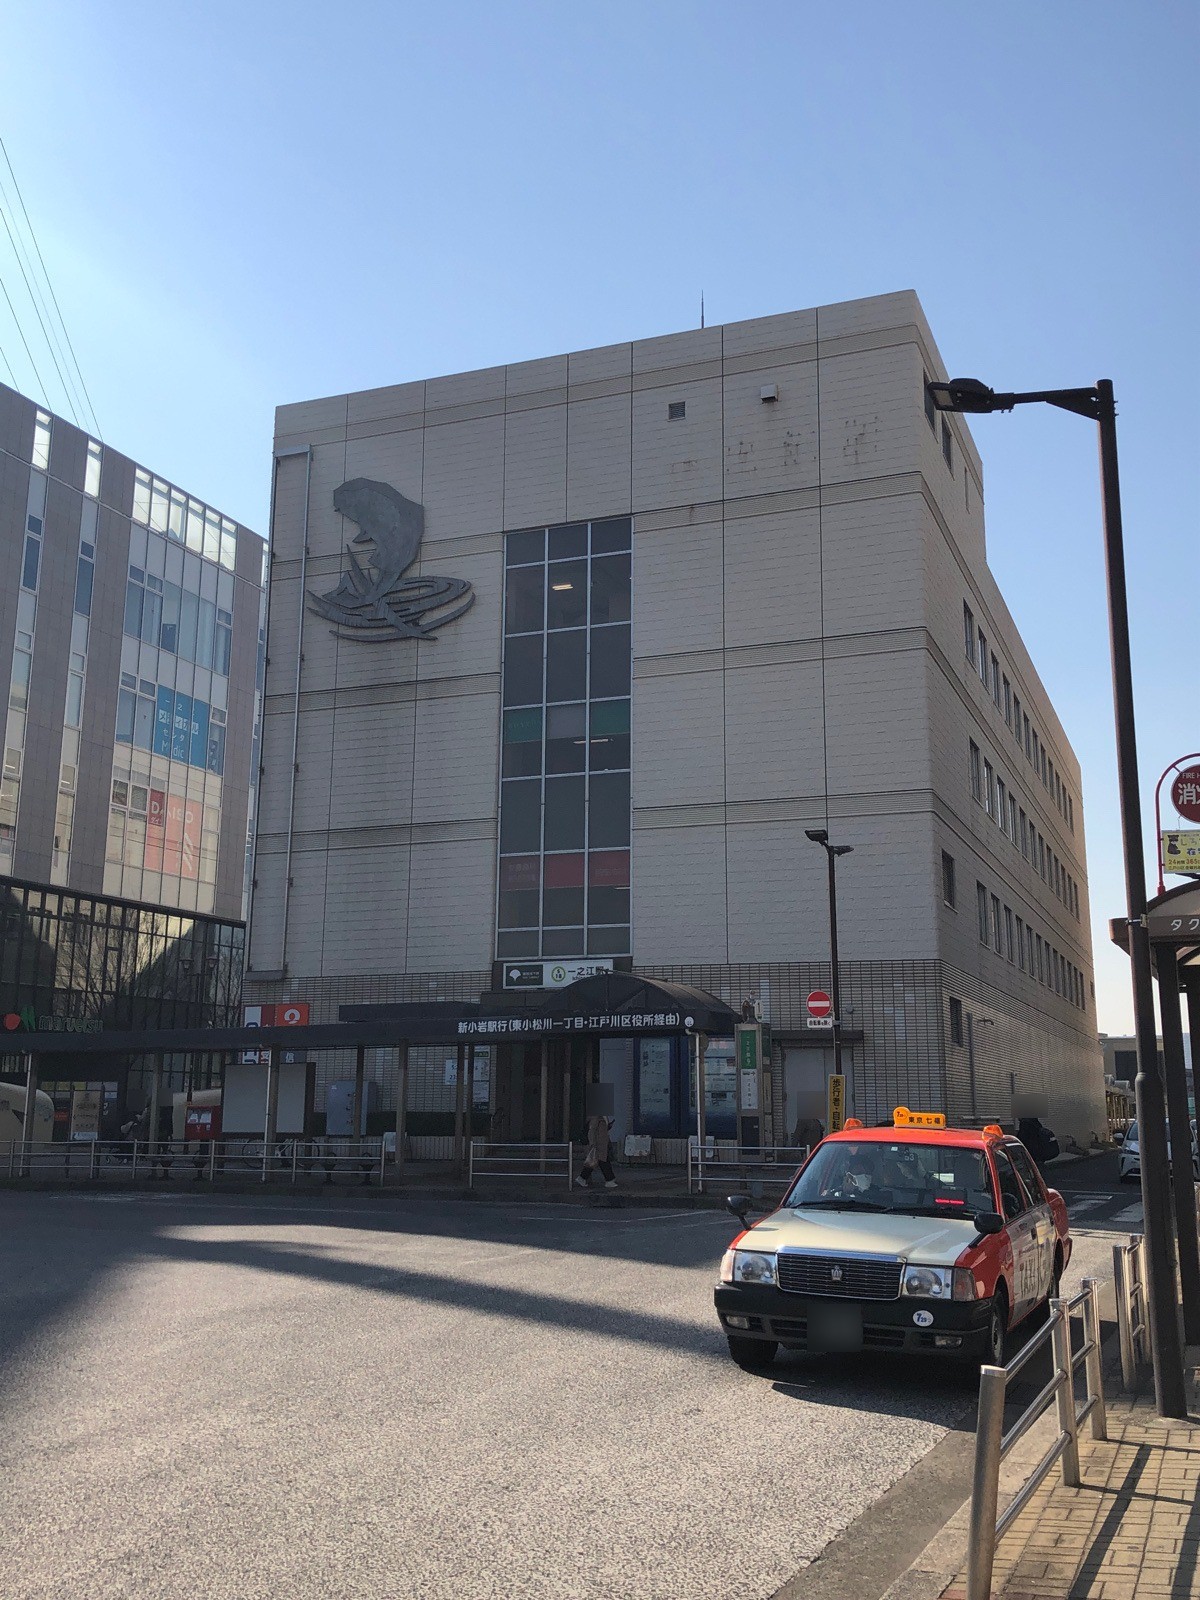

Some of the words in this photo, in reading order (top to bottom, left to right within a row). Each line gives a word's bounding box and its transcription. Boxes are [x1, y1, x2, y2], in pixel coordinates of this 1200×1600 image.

[832, 1078, 842, 1134] 歩行者・自転
